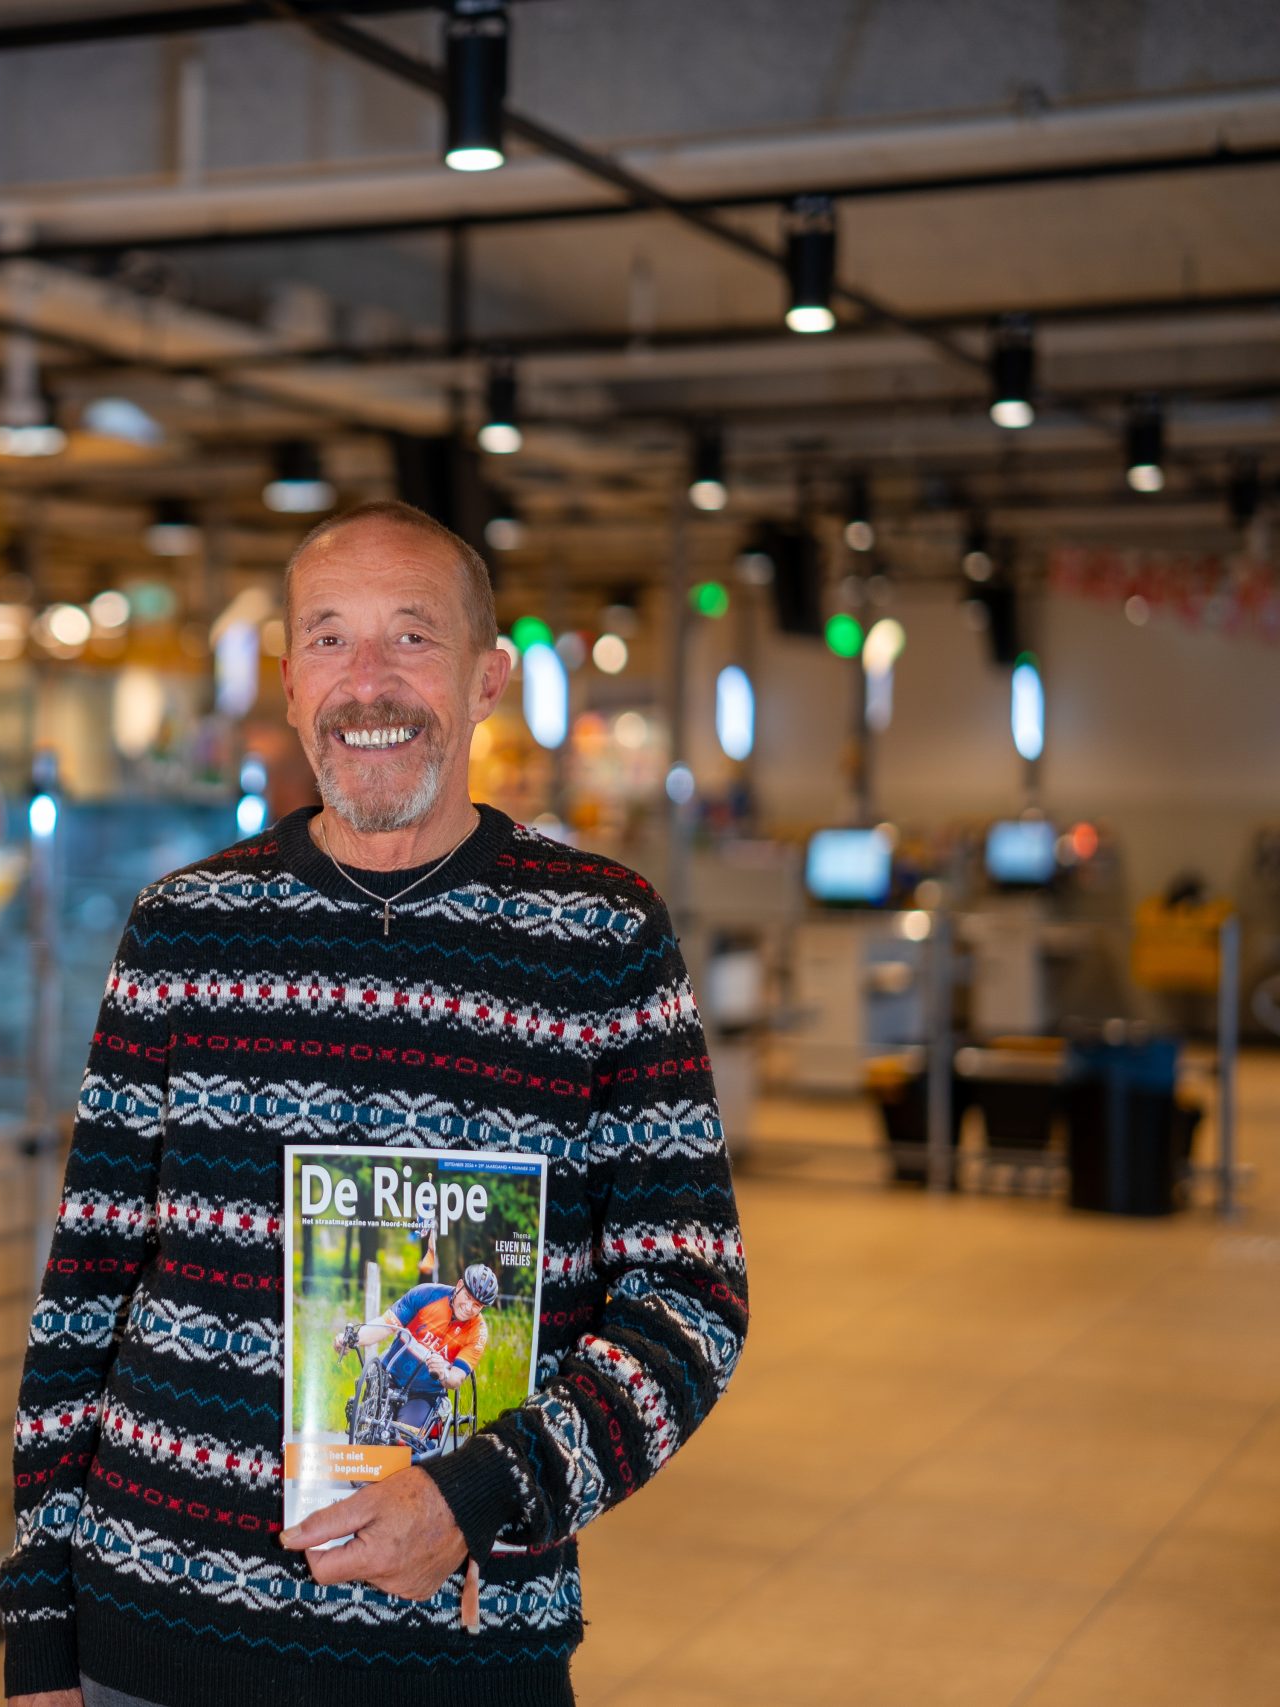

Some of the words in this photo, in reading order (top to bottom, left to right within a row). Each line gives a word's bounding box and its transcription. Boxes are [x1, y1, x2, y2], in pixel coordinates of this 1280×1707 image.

[301, 1164, 359, 1216] De
[374, 1165, 489, 1236] Riepe
[302, 1217, 314, 1225] Het
[315, 1218, 367, 1228] straatmagazine
[495, 1240, 520, 1253] LEVEN
[520, 1241, 531, 1253] NA
[500, 1254, 531, 1267] VERLIES
[329, 1451, 344, 1460] het
[346, 1451, 364, 1460] niet
